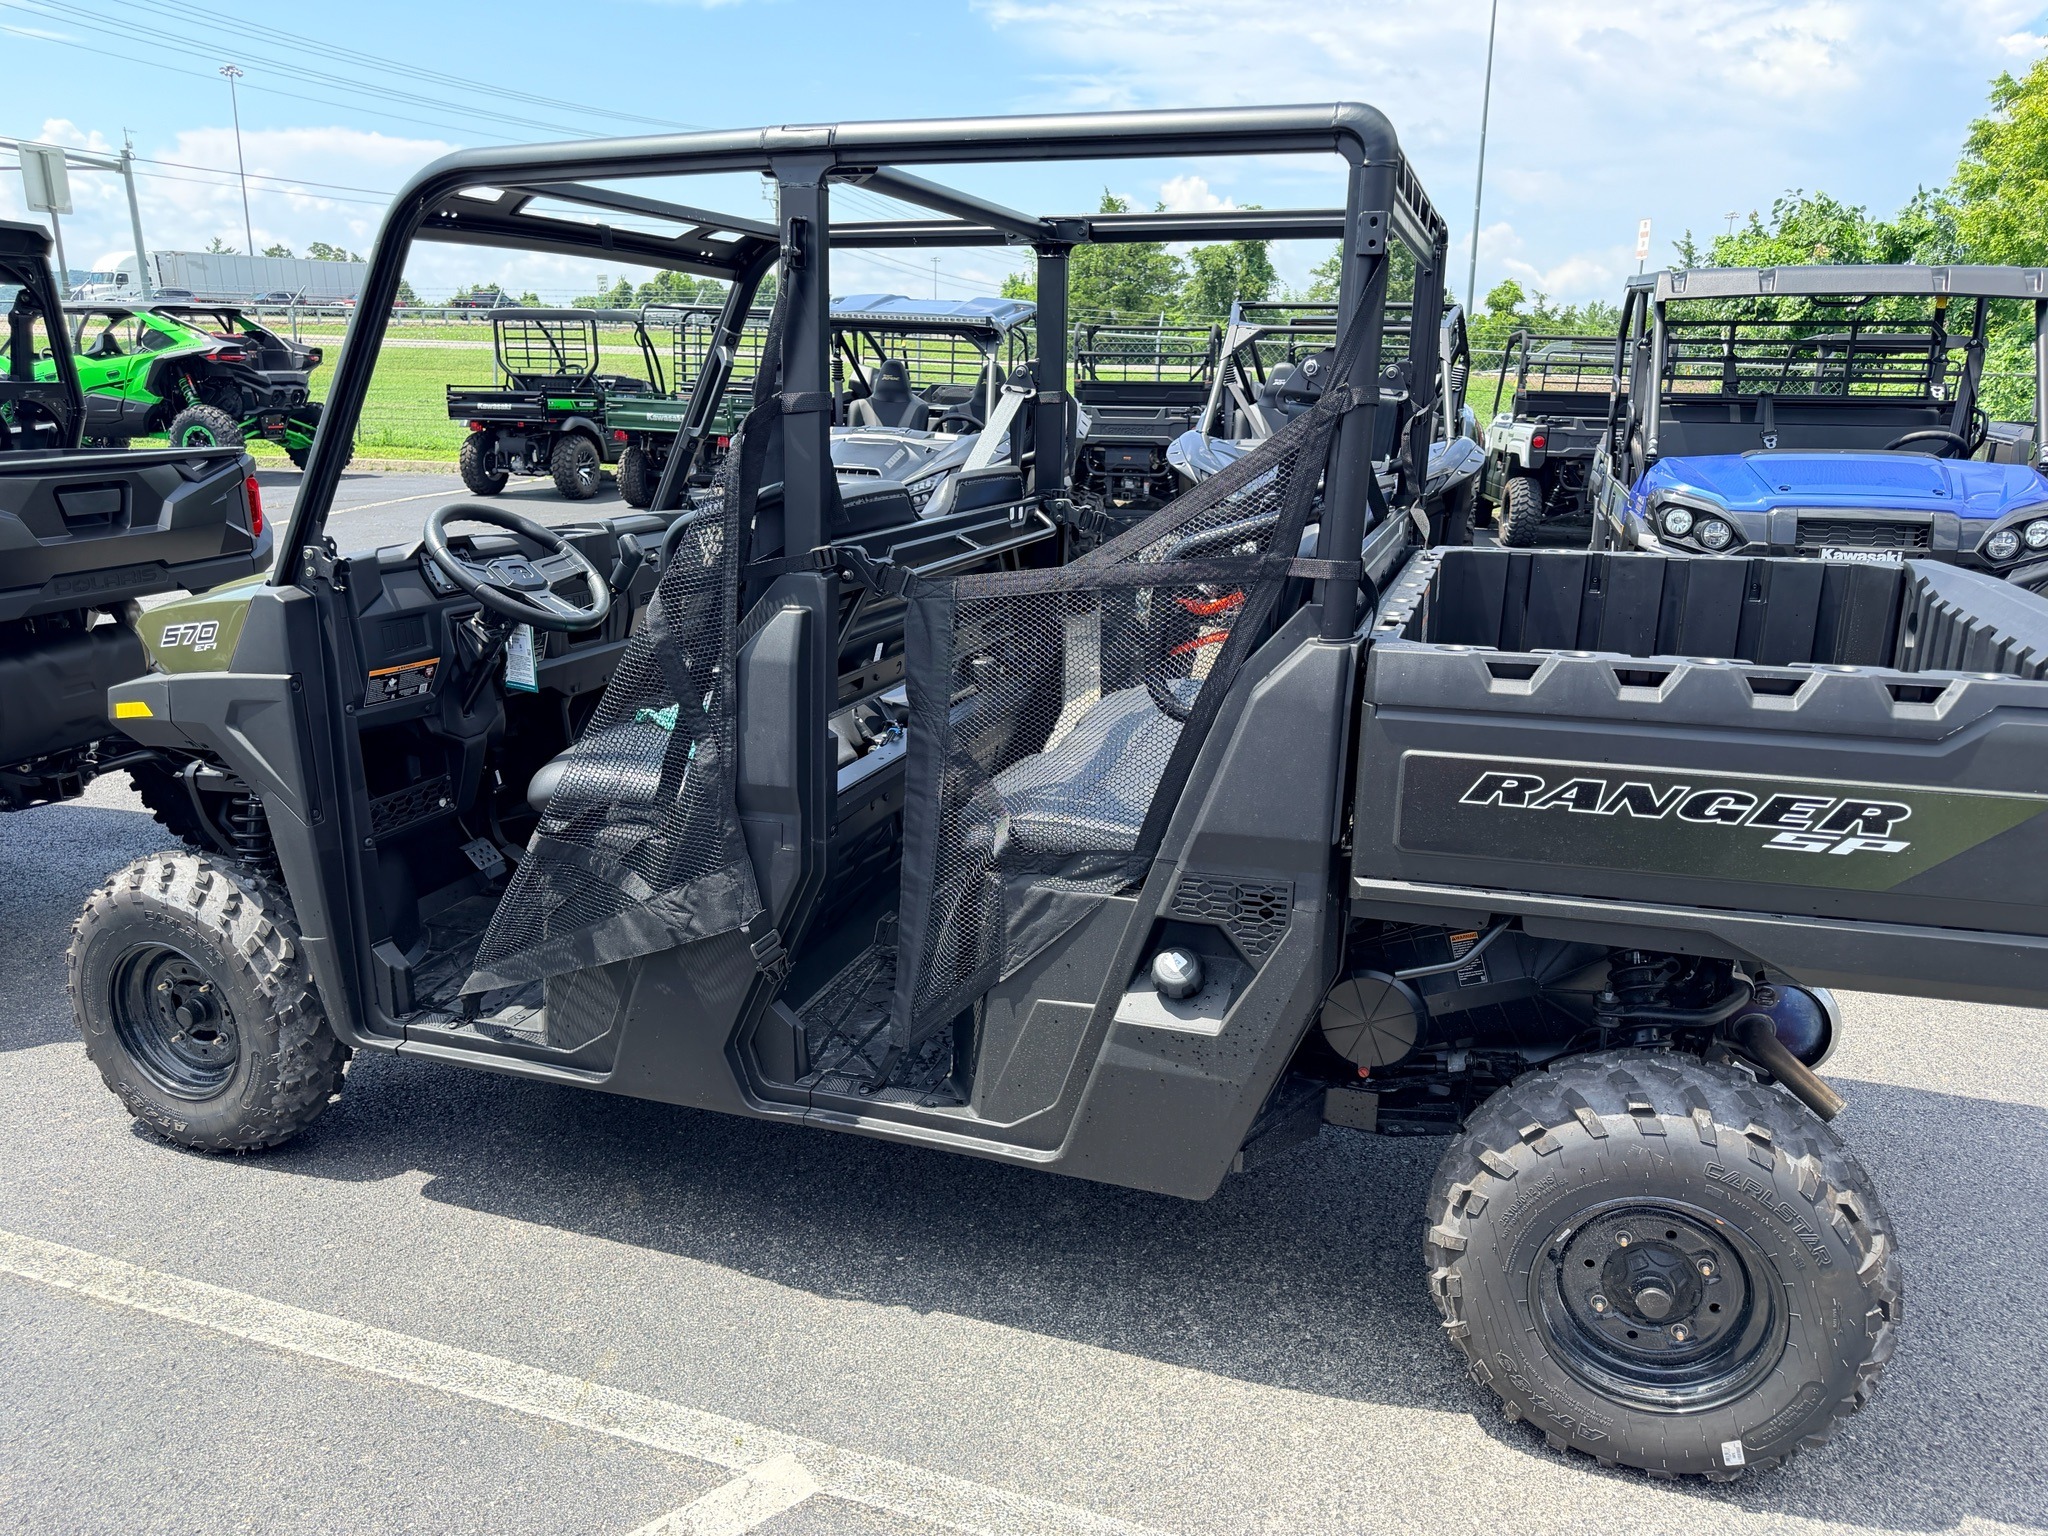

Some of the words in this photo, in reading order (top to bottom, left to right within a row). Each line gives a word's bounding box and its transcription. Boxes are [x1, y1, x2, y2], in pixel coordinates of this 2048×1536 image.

[477, 402, 512, 410] Kawasaki
[1820, 548, 1903, 563] Kawasaki
[54, 568, 157, 595] POLARIS
[160, 620, 219, 647] 570
[194, 642, 217, 652] EFI
[1459, 771, 1912, 837] RANGER
[1762, 832, 1911, 855] SP
[1534, 1174, 1554, 1191] NHS
[1703, 1161, 1832, 1267] CARLSTAR
[1496, 1352, 1607, 1440] AT489
